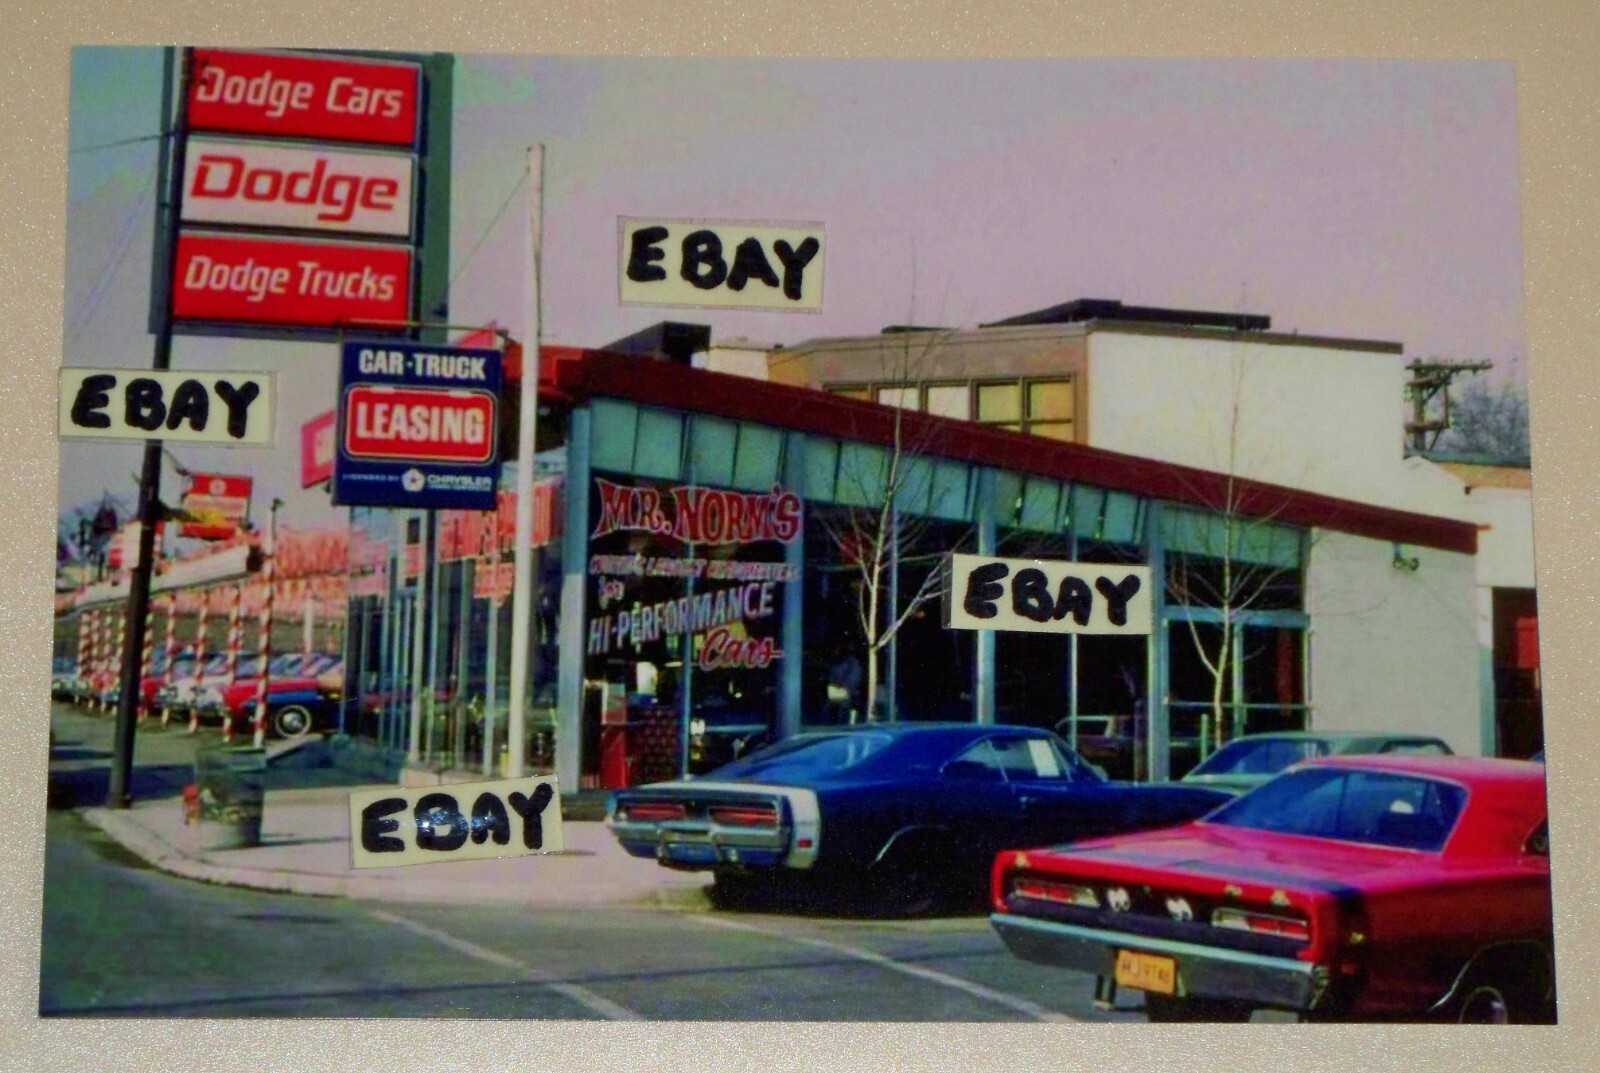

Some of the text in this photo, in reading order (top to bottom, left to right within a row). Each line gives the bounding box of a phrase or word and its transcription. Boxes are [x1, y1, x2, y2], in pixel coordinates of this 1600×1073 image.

[196, 66, 403, 118] Dodge Cars
[191, 153, 399, 223] Dodge
[184, 255, 397, 303] Dodge Trucks
[626, 226, 820, 301] EBAY
[70, 374, 260, 438] EBAY
[356, 401, 486, 445] LEASING
[669, 482, 803, 544] NORM'S
[964, 562, 1141, 627] EBAY
[699, 625, 784, 672] Cars
[361, 782, 554, 852] EBAY
